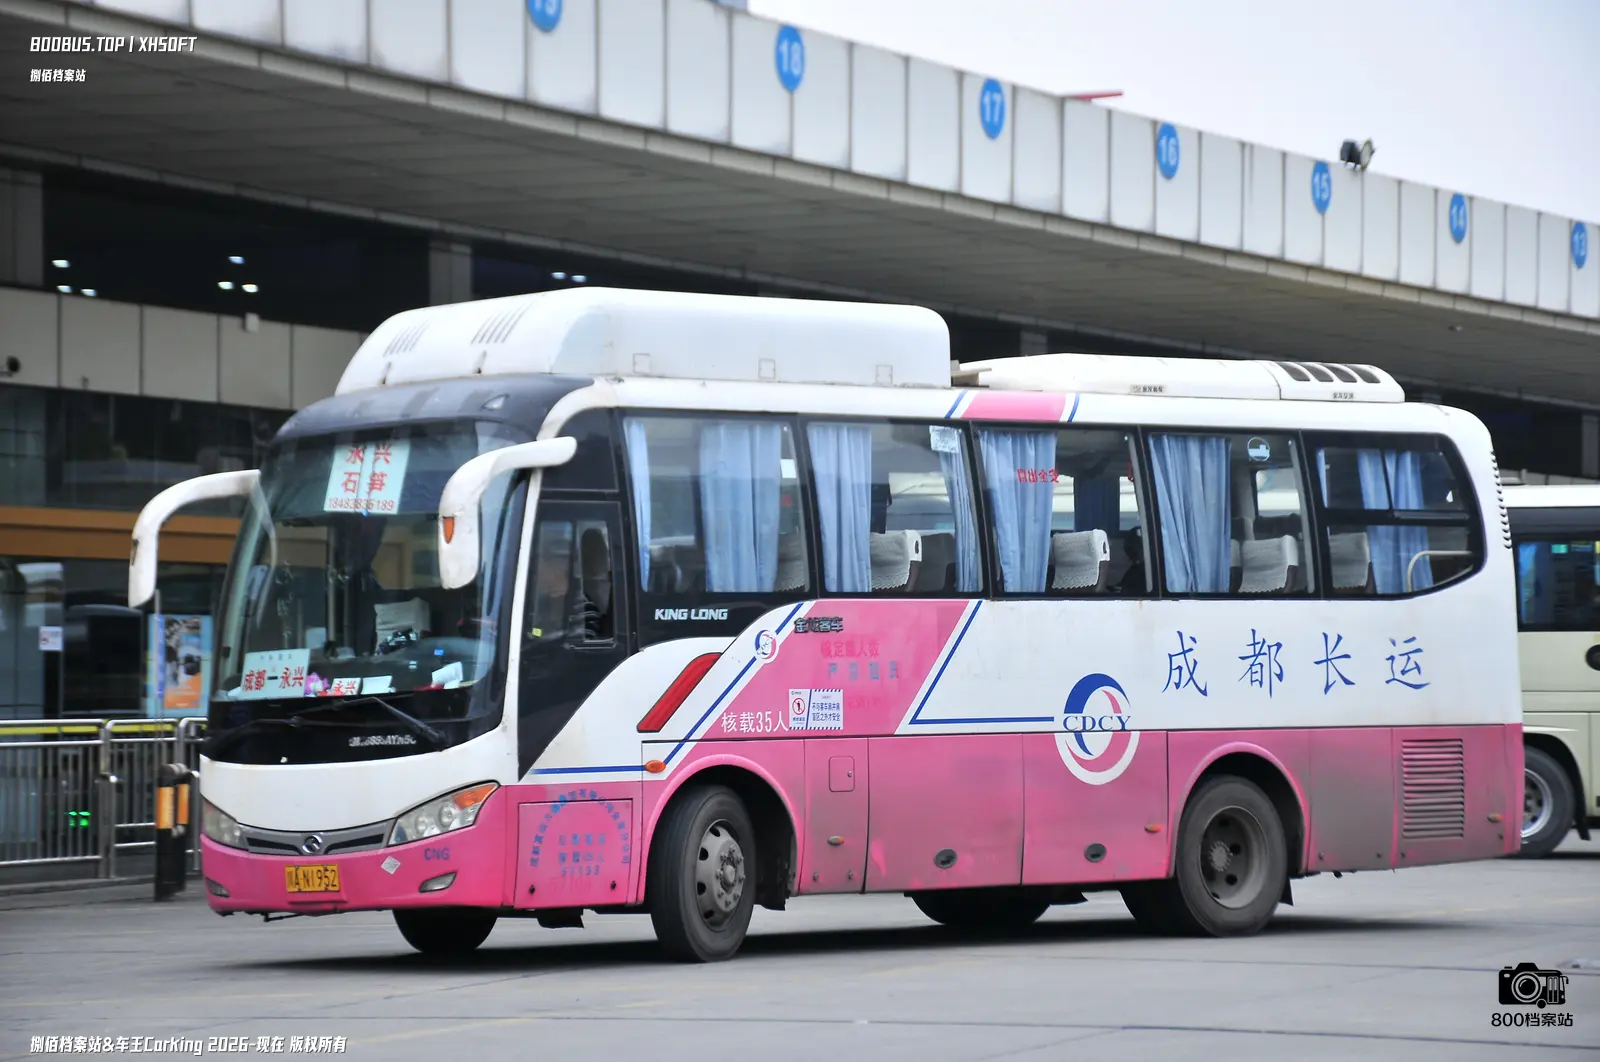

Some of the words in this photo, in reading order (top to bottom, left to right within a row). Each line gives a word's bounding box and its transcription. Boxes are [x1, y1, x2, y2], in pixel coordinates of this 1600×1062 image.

[779, 38, 801, 77] 18
[983, 91, 1000, 125] 17
[1159, 135, 1177, 167] 16
[1313, 172, 1329, 201] 15
[1451, 205, 1464, 230] 14
[654, 608, 688, 621] KING
[690, 608, 728, 621] LONG
[1162, 628, 1431, 698] 成都长运
[721, 711, 789, 733] 核载35人
[1062, 715, 1132, 732] CDCY
[424, 847, 450, 860] CNG
